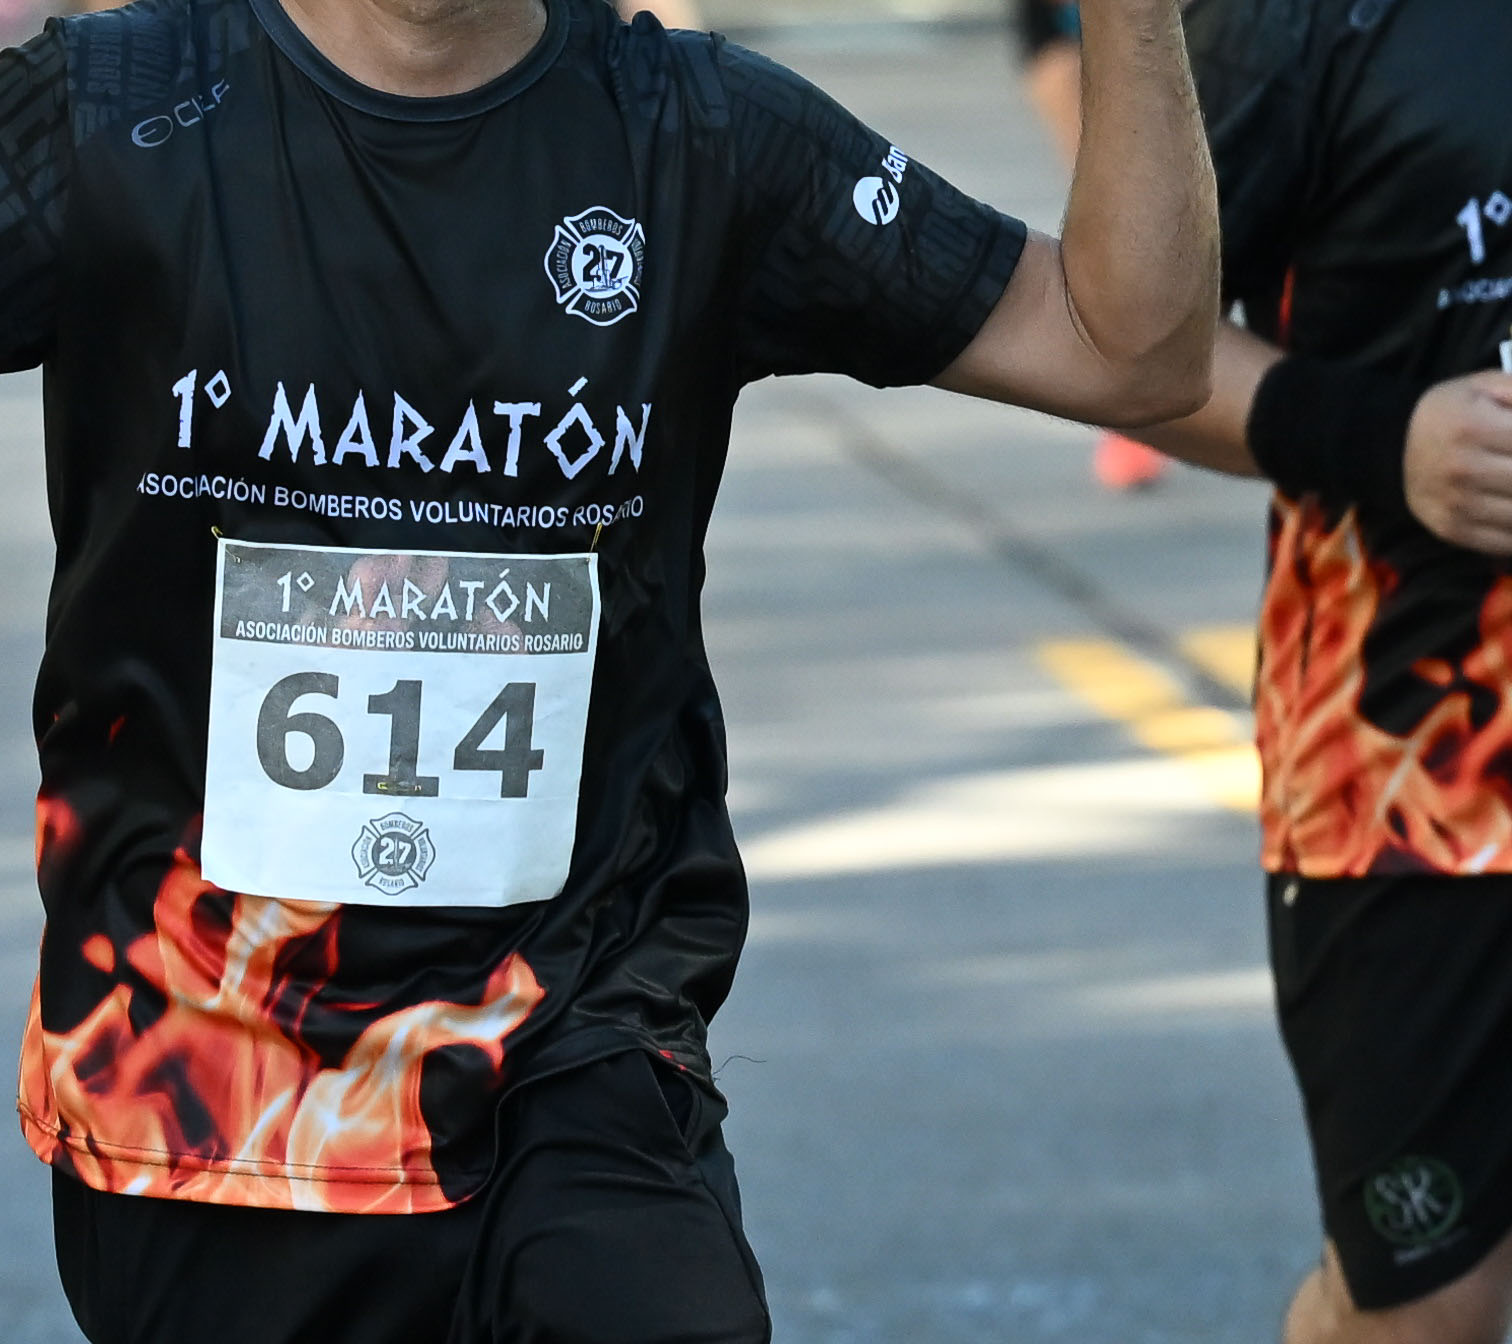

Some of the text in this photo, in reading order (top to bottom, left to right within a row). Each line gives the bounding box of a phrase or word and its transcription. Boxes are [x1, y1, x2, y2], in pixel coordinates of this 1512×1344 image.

[583, 243, 625, 283] 27
[258, 376, 652, 480] MARATÓN
[273, 486, 402, 520] BOMBEROS
[409, 500, 568, 528] VOLUNTARIOS
[329, 568, 552, 623] MARATÓN
[235, 620, 584, 652] ASOCIACIÓN BOMBEROS VOLUNTARIOS ROSARIO
[256, 671, 545, 799] 614
[379, 837, 412, 865] 27
